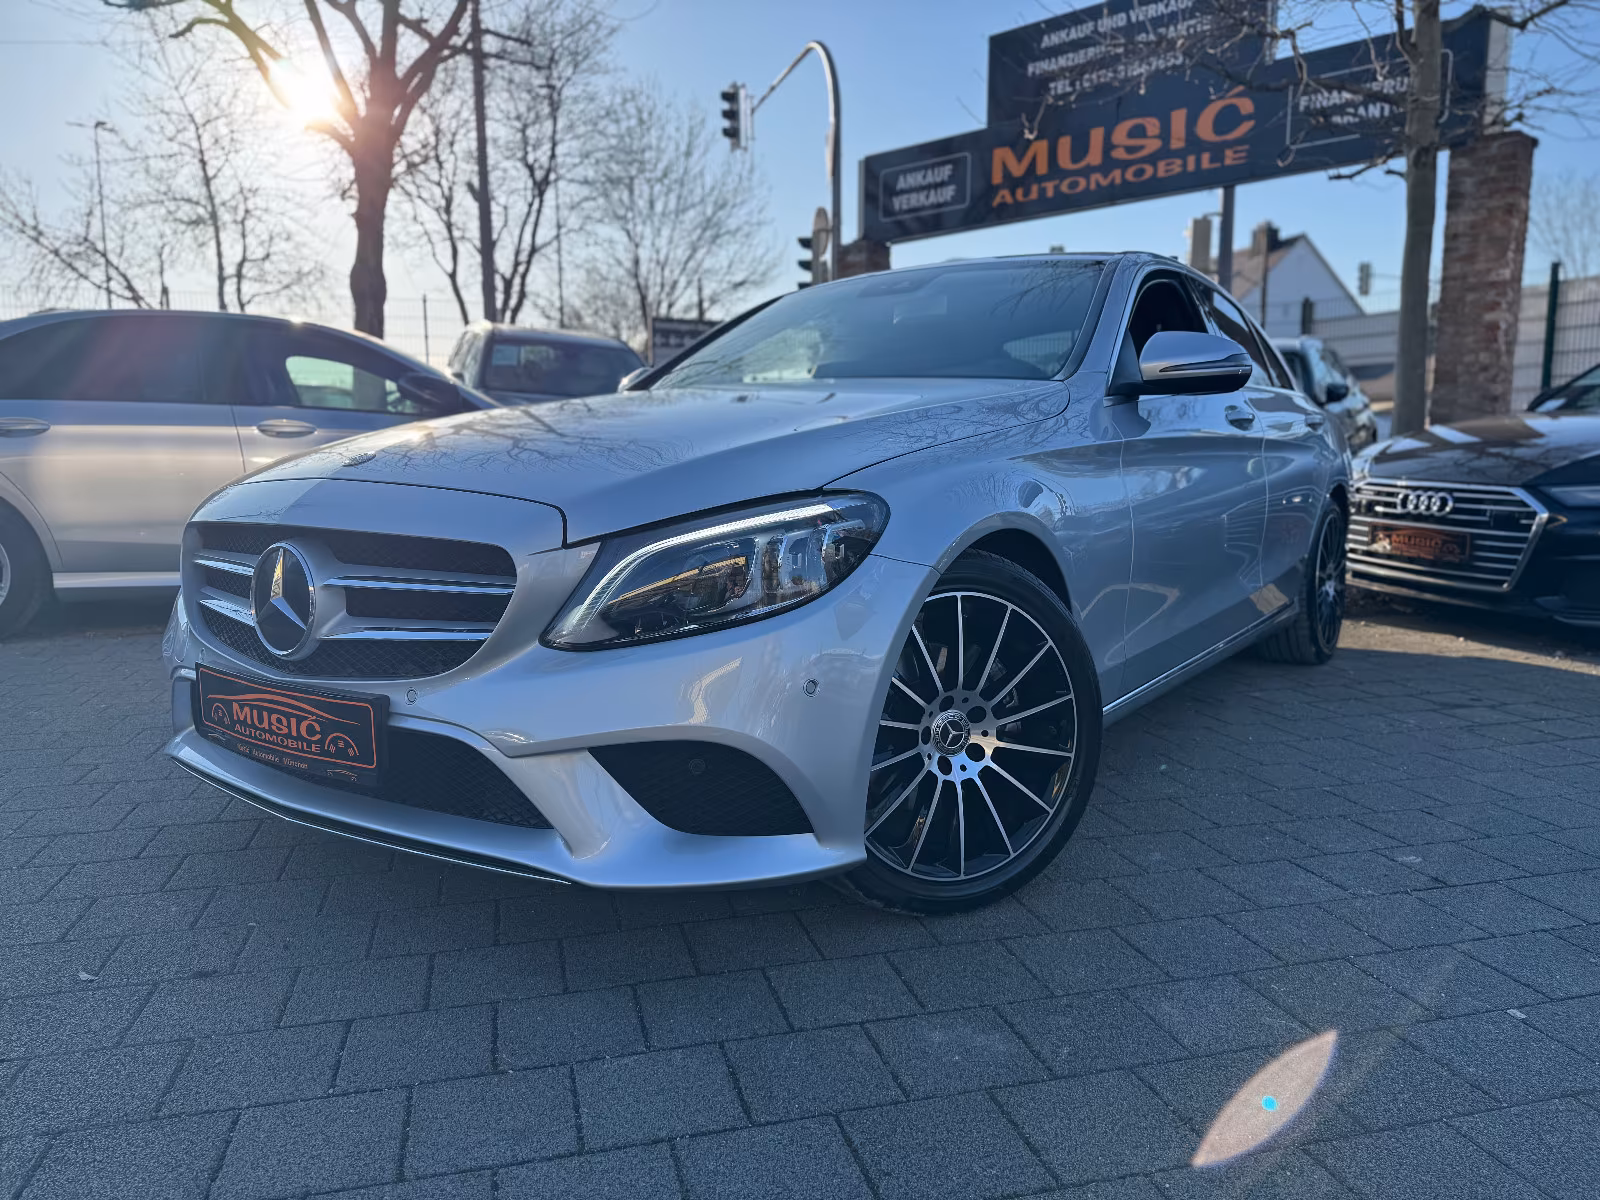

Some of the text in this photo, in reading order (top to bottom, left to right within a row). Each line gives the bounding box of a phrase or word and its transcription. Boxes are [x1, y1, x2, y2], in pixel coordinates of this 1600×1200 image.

[1040, 21, 1095, 49] ANKAUF
[1097, 12, 1127, 33] UND
[991, 84, 1257, 186] MUSIĆ
[896, 163, 954, 190] ANKAUF
[992, 145, 1251, 208] AUTOMOBILE
[892, 185, 957, 212] VERKAUF
[232, 701, 322, 742] MUSIĆ
[234, 722, 321, 753] AUTOMOBILE
